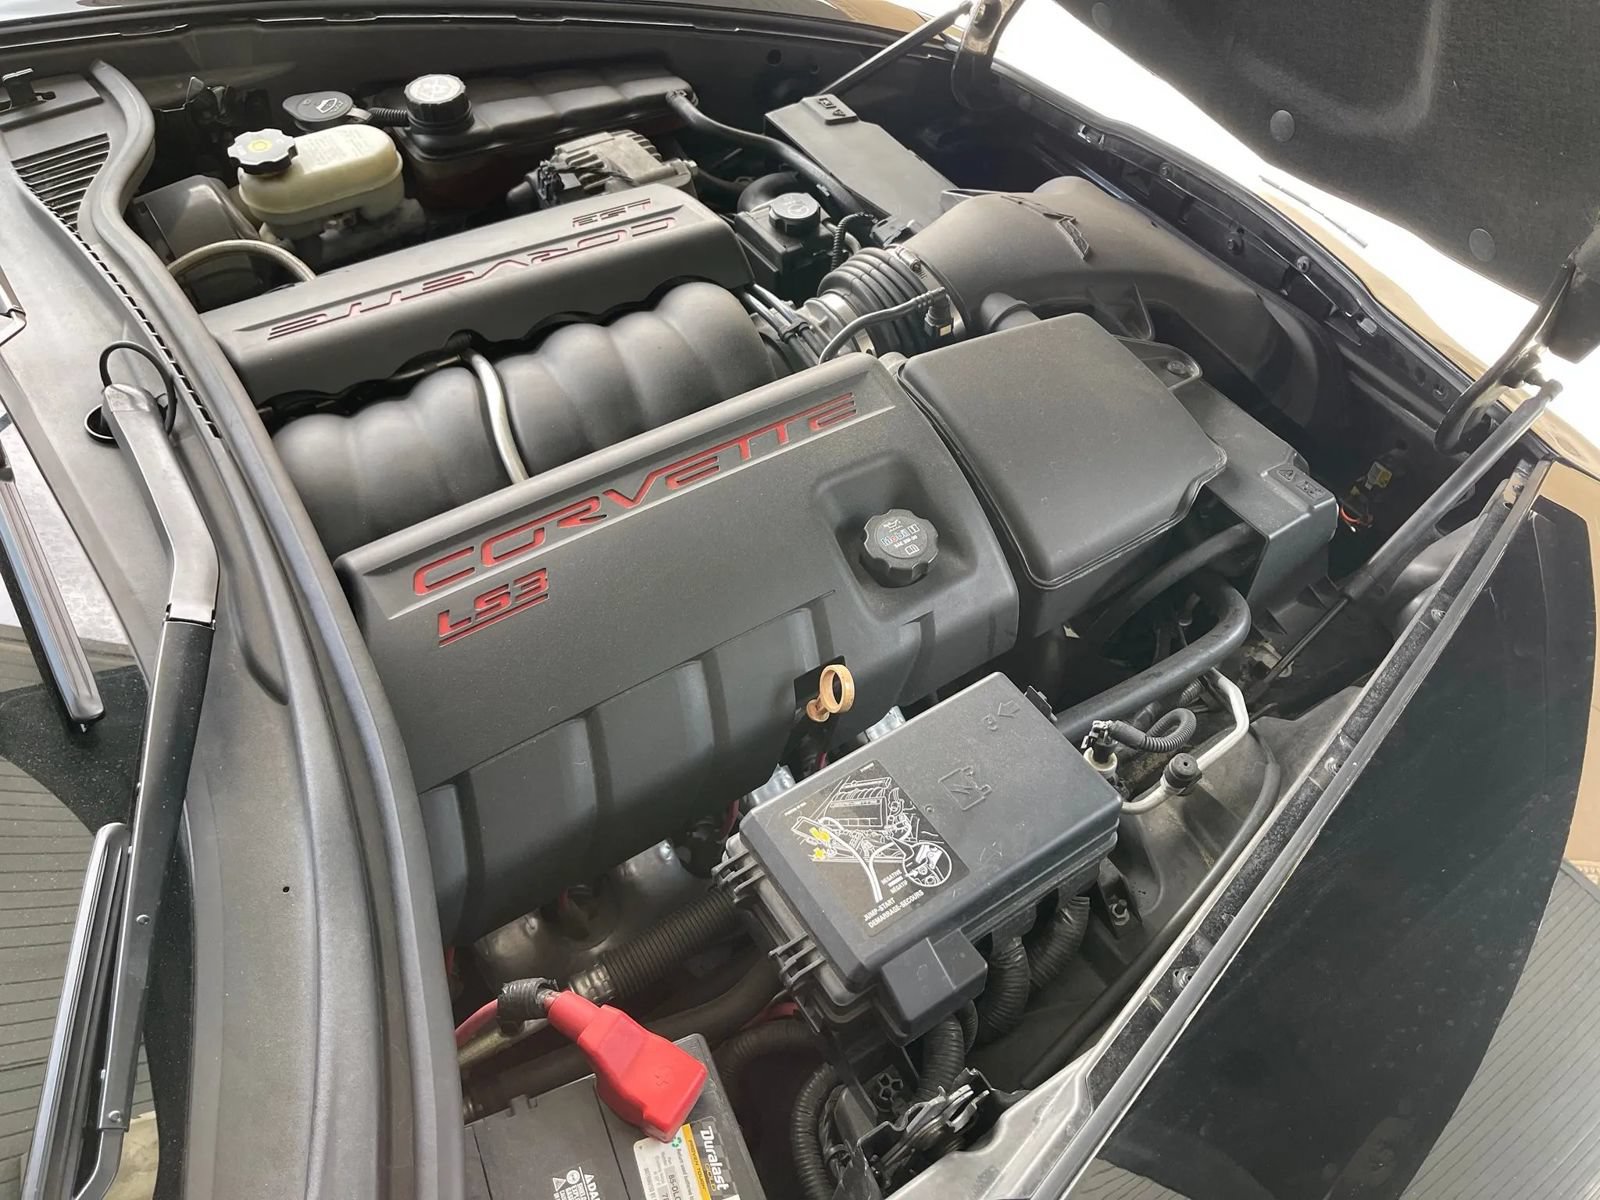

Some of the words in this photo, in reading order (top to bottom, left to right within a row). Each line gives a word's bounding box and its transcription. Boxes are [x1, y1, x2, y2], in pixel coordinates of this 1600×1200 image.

[266, 216, 677, 341] CORVETTE
[412, 391, 858, 597] CORVETTE
[437, 567, 550, 639] LS3
[863, 897, 895, 921] JUMP-START
[867, 889, 924, 928] DEMARRAGE-SECOURS
[700, 1125, 730, 1191] Duralast
[704, 1162, 717, 1192] GOLD
